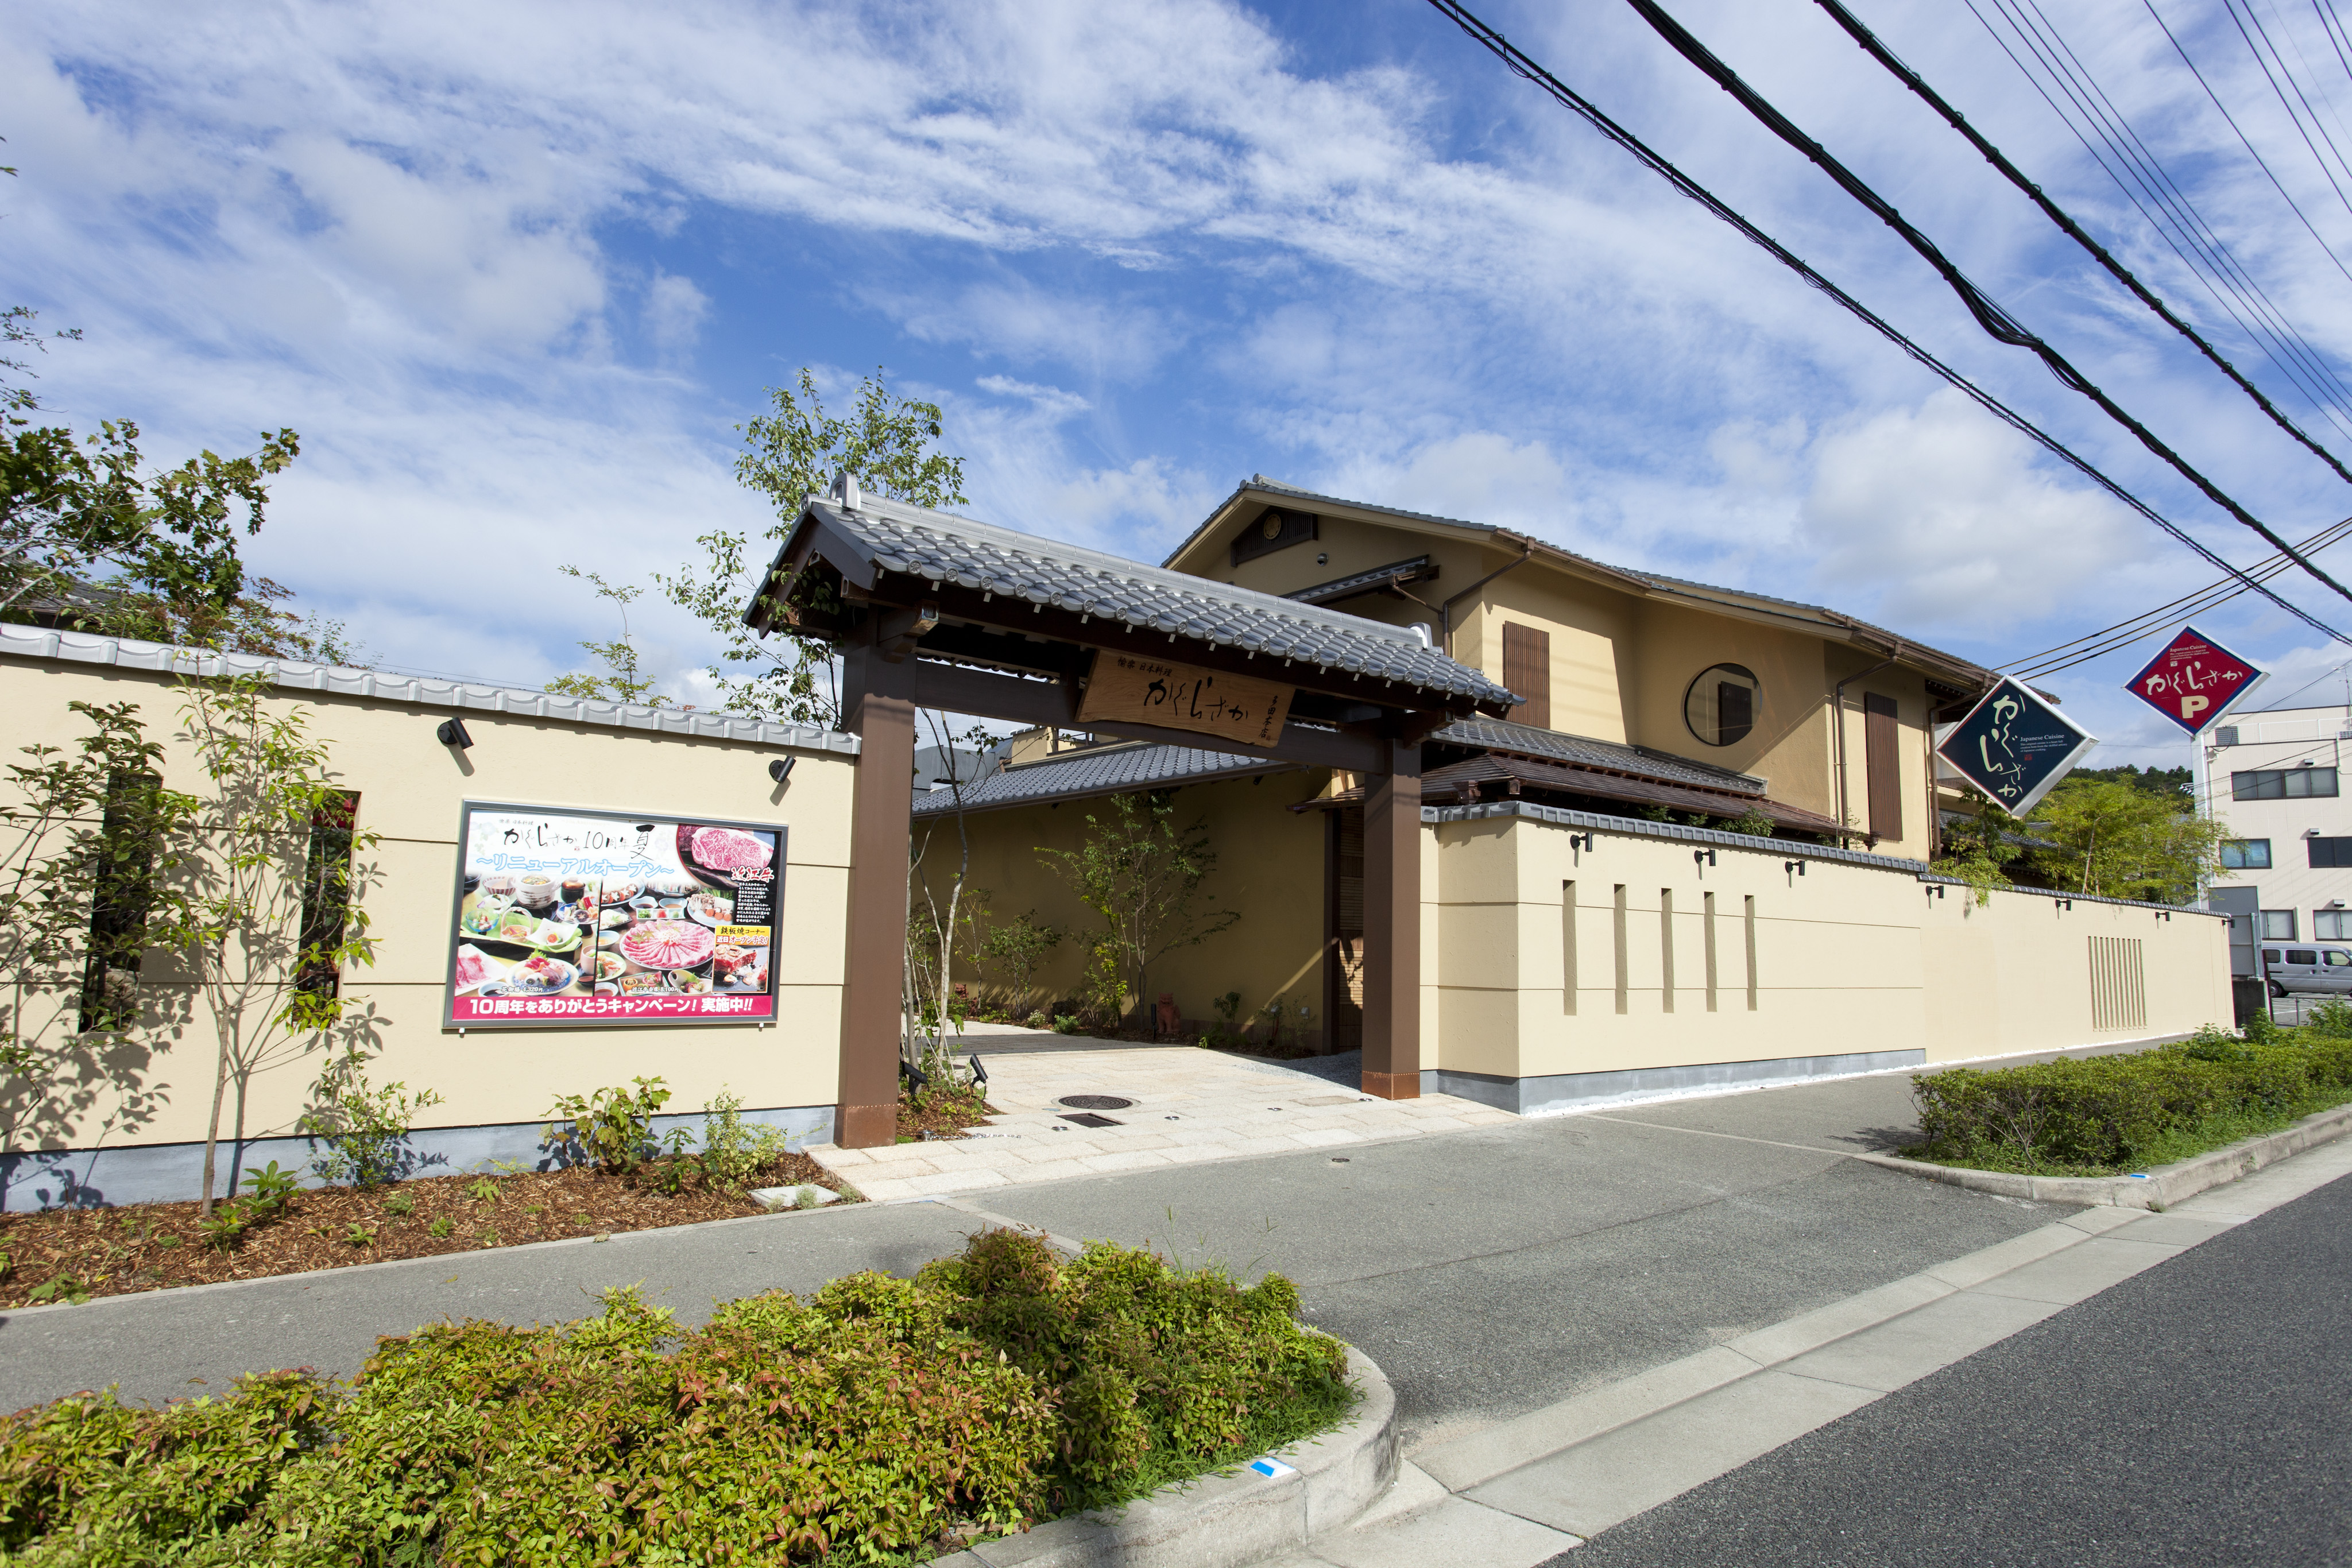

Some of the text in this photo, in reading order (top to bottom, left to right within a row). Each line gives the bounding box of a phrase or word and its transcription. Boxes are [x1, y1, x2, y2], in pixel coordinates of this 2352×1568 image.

[1139, 663, 1173, 677] 日本料理
[2181, 695, 2209, 719] P
[1259, 695, 1278, 738] 多田本店
[731, 865, 775, 883] 近江牛
[721, 927, 765, 935] 鉄板焼コーナー
